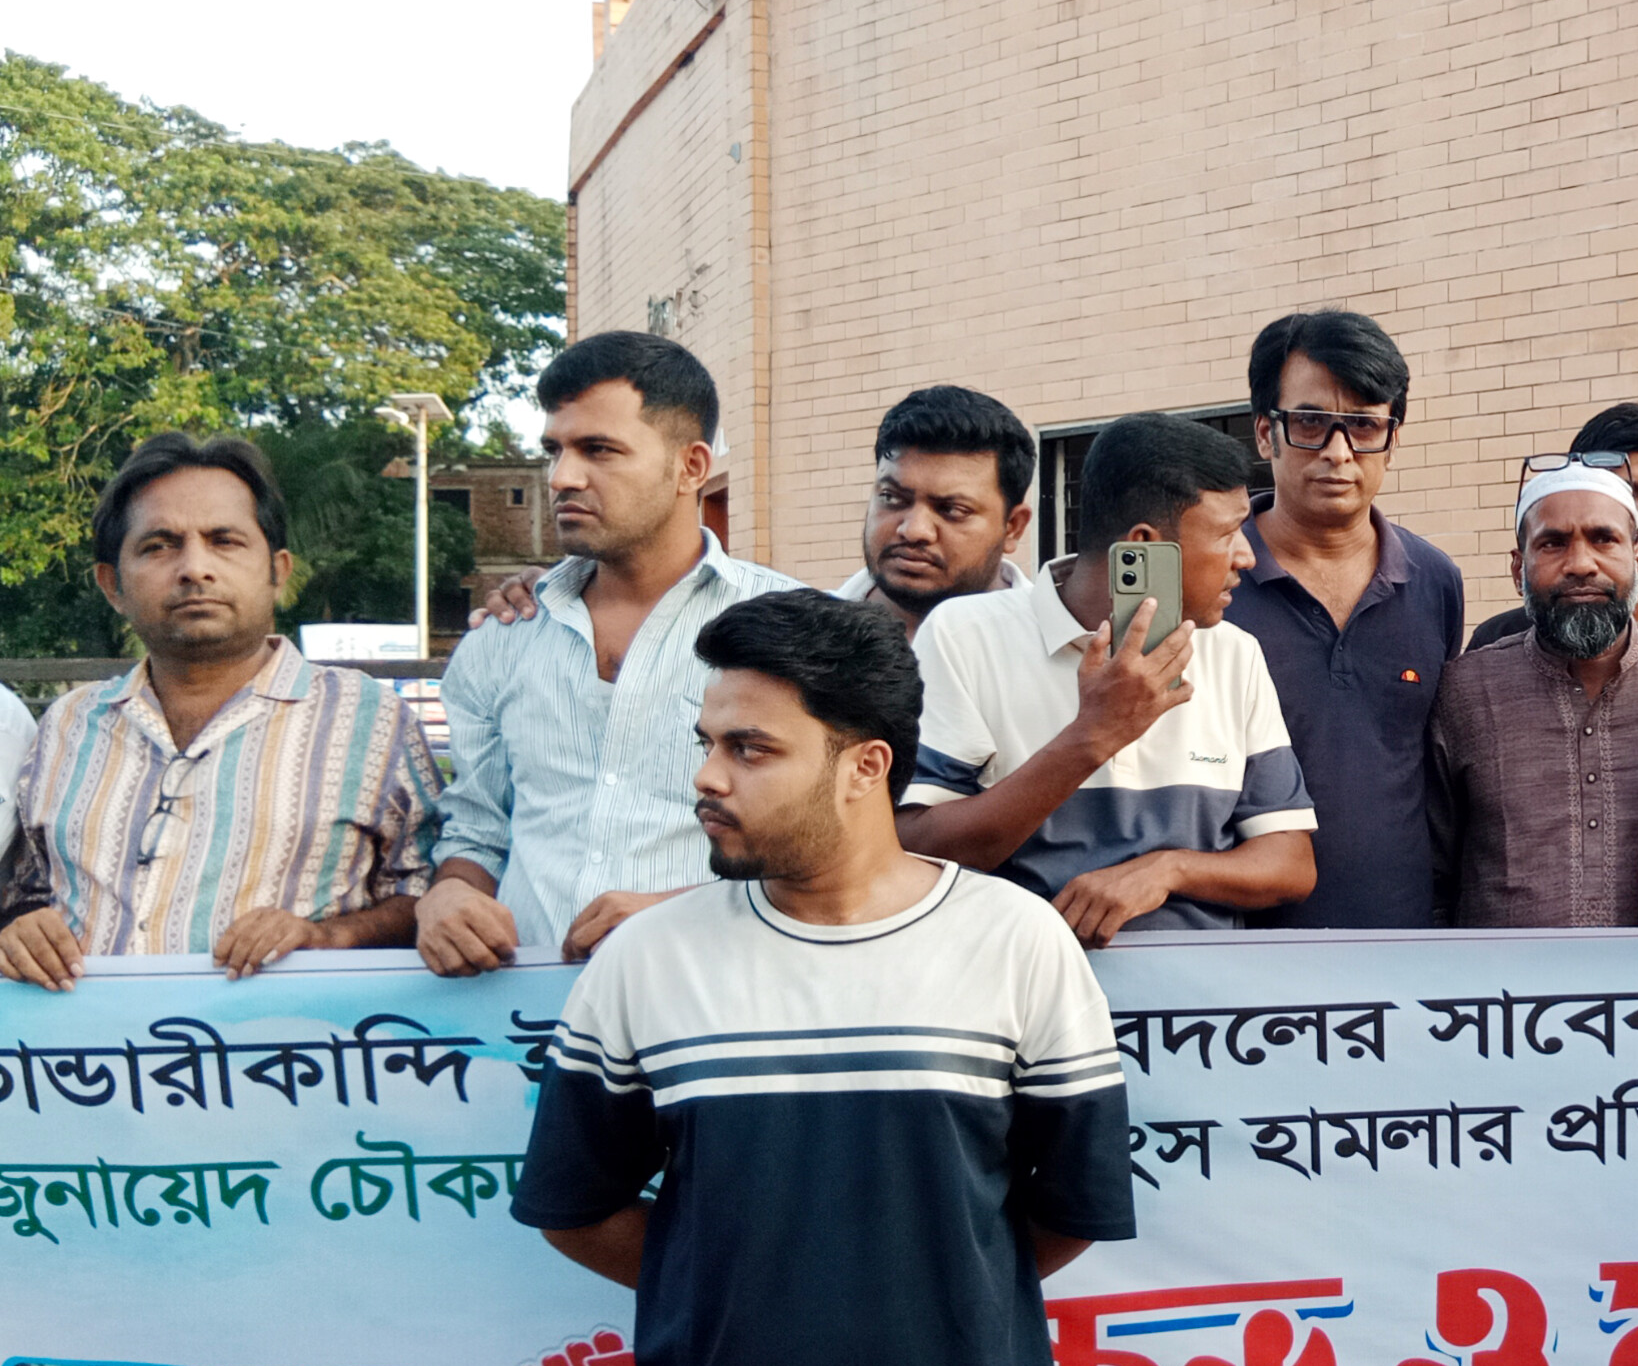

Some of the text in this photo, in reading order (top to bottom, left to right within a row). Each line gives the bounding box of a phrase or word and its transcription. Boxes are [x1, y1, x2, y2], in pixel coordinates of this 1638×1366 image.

[0, 1014, 487, 1115] ান্ডারীকান্দি
[1110, 1001, 1401, 1077] বদলের
[1239, 1099, 1525, 1182] হামলার
